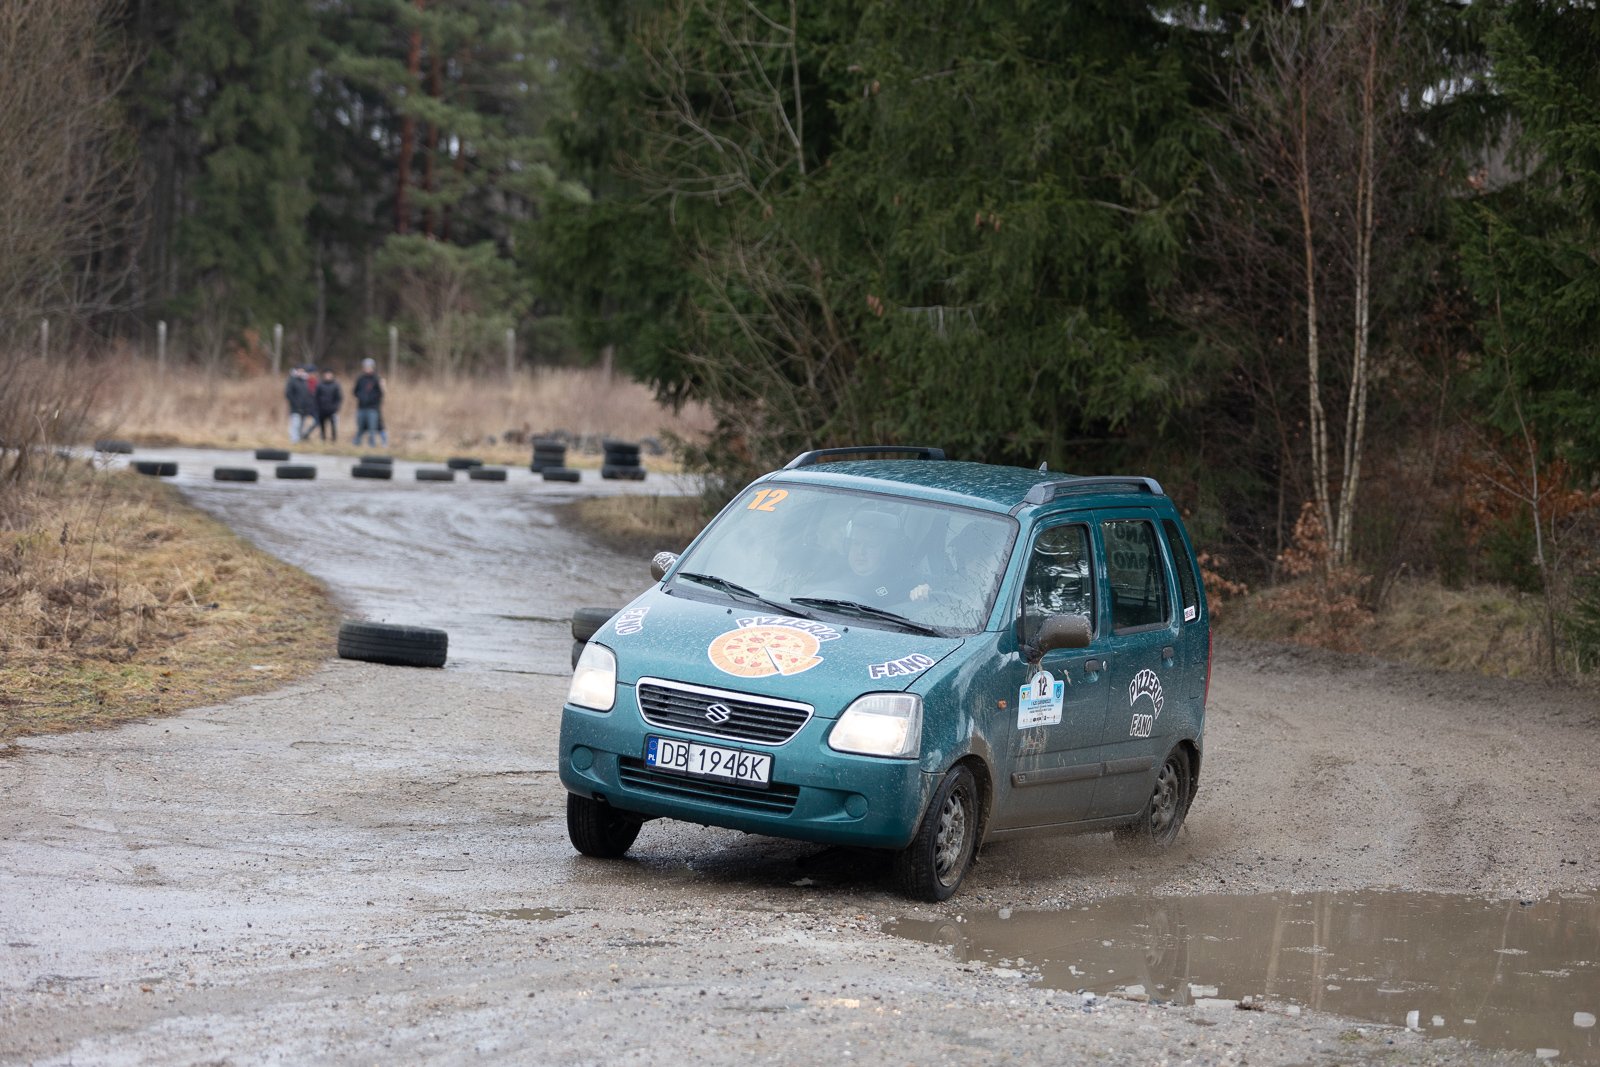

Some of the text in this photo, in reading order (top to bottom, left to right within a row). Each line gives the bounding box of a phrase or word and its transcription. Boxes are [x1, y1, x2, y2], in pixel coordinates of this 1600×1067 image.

[747, 488, 788, 512] 12
[653, 551, 676, 573] FAN
[615, 607, 650, 635] FANO
[737, 615, 840, 642] PIZZERIA
[869, 653, 934, 679] FANO
[1038, 674, 1047, 696] 12
[1129, 669, 1164, 719] PIZZERIA
[1130, 714, 1153, 737] FANO
[661, 742, 764, 781] DB 1946K
